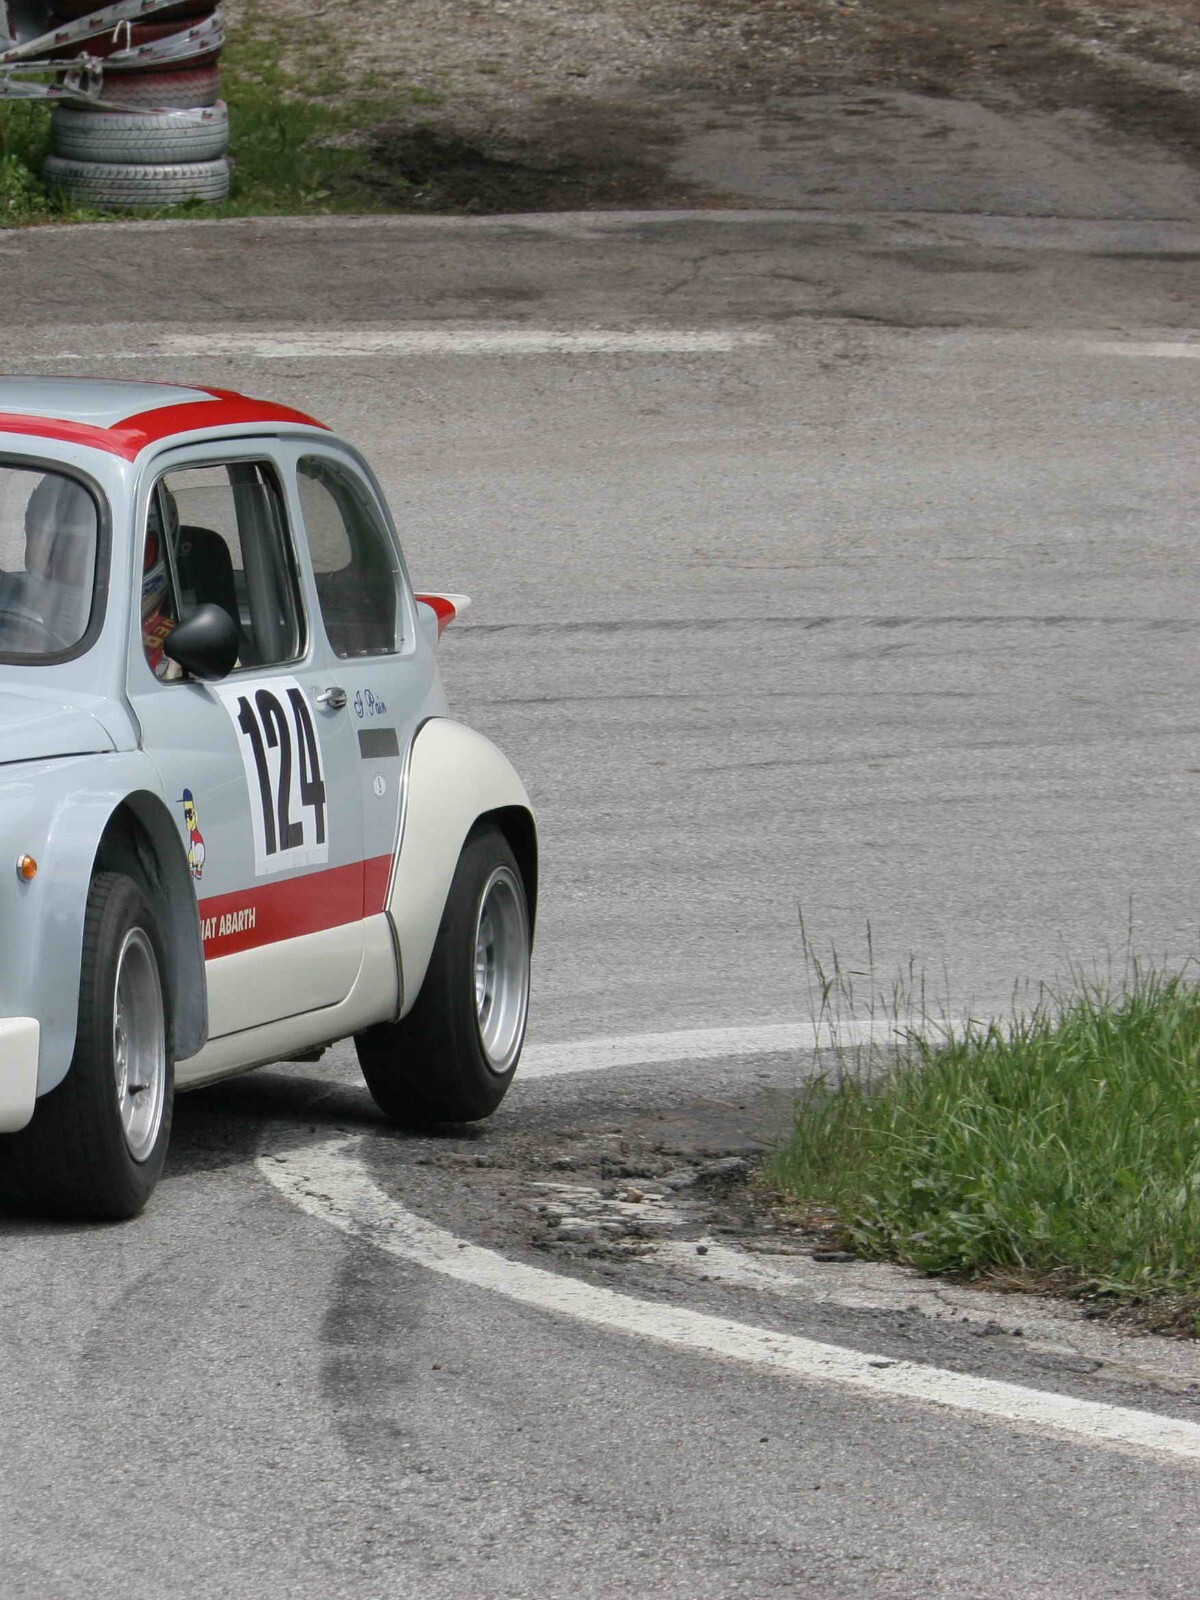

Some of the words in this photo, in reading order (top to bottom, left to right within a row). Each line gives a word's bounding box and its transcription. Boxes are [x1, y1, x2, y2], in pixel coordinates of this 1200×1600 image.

[237, 687, 326, 856] 124
[200, 917, 217, 941] IAT
[218, 907, 256, 937] ABARTH
